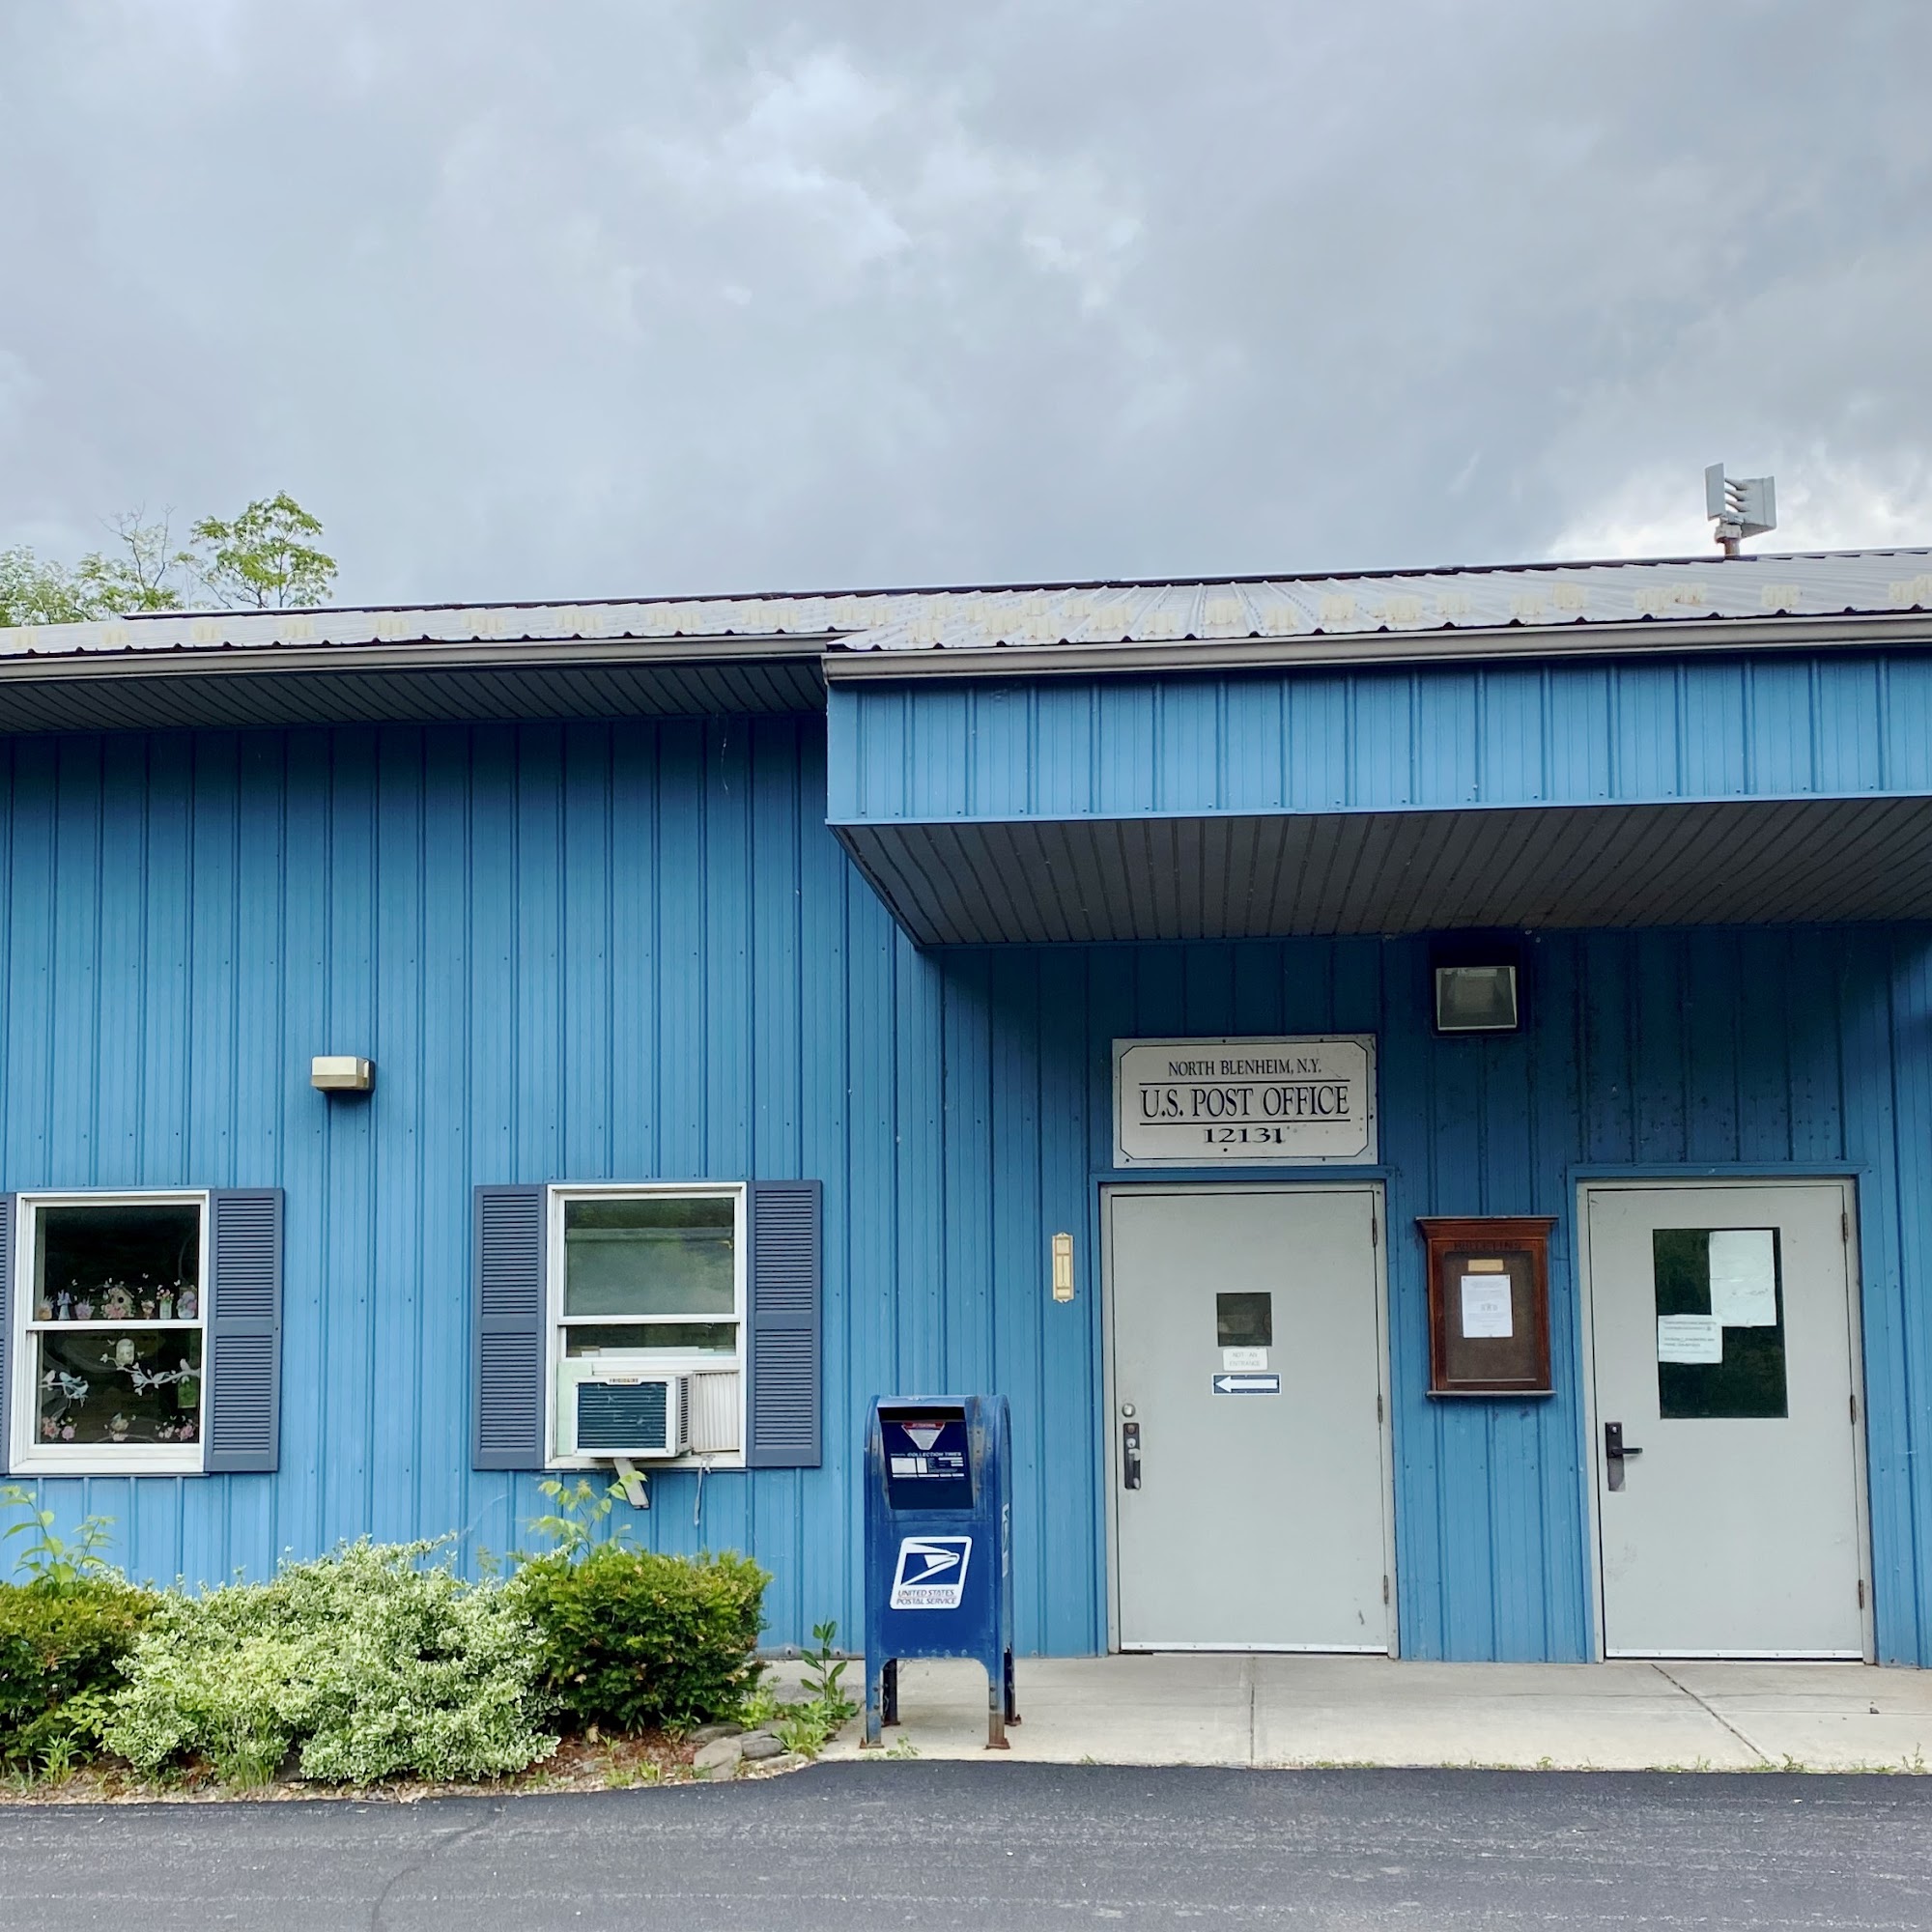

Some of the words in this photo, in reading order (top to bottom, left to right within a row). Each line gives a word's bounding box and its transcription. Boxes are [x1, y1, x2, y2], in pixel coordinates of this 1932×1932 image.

[1168, 1061, 1214, 1076] NORTH
[1221, 1059, 1293, 1076] BLENHEIM,
[1296, 1058, 1321, 1073] N.Y.
[1140, 1089, 1183, 1118] U.S.
[1191, 1088, 1253, 1117] POST
[1263, 1086, 1350, 1117] OFFICE
[1204, 1127, 1286, 1144] 12131
